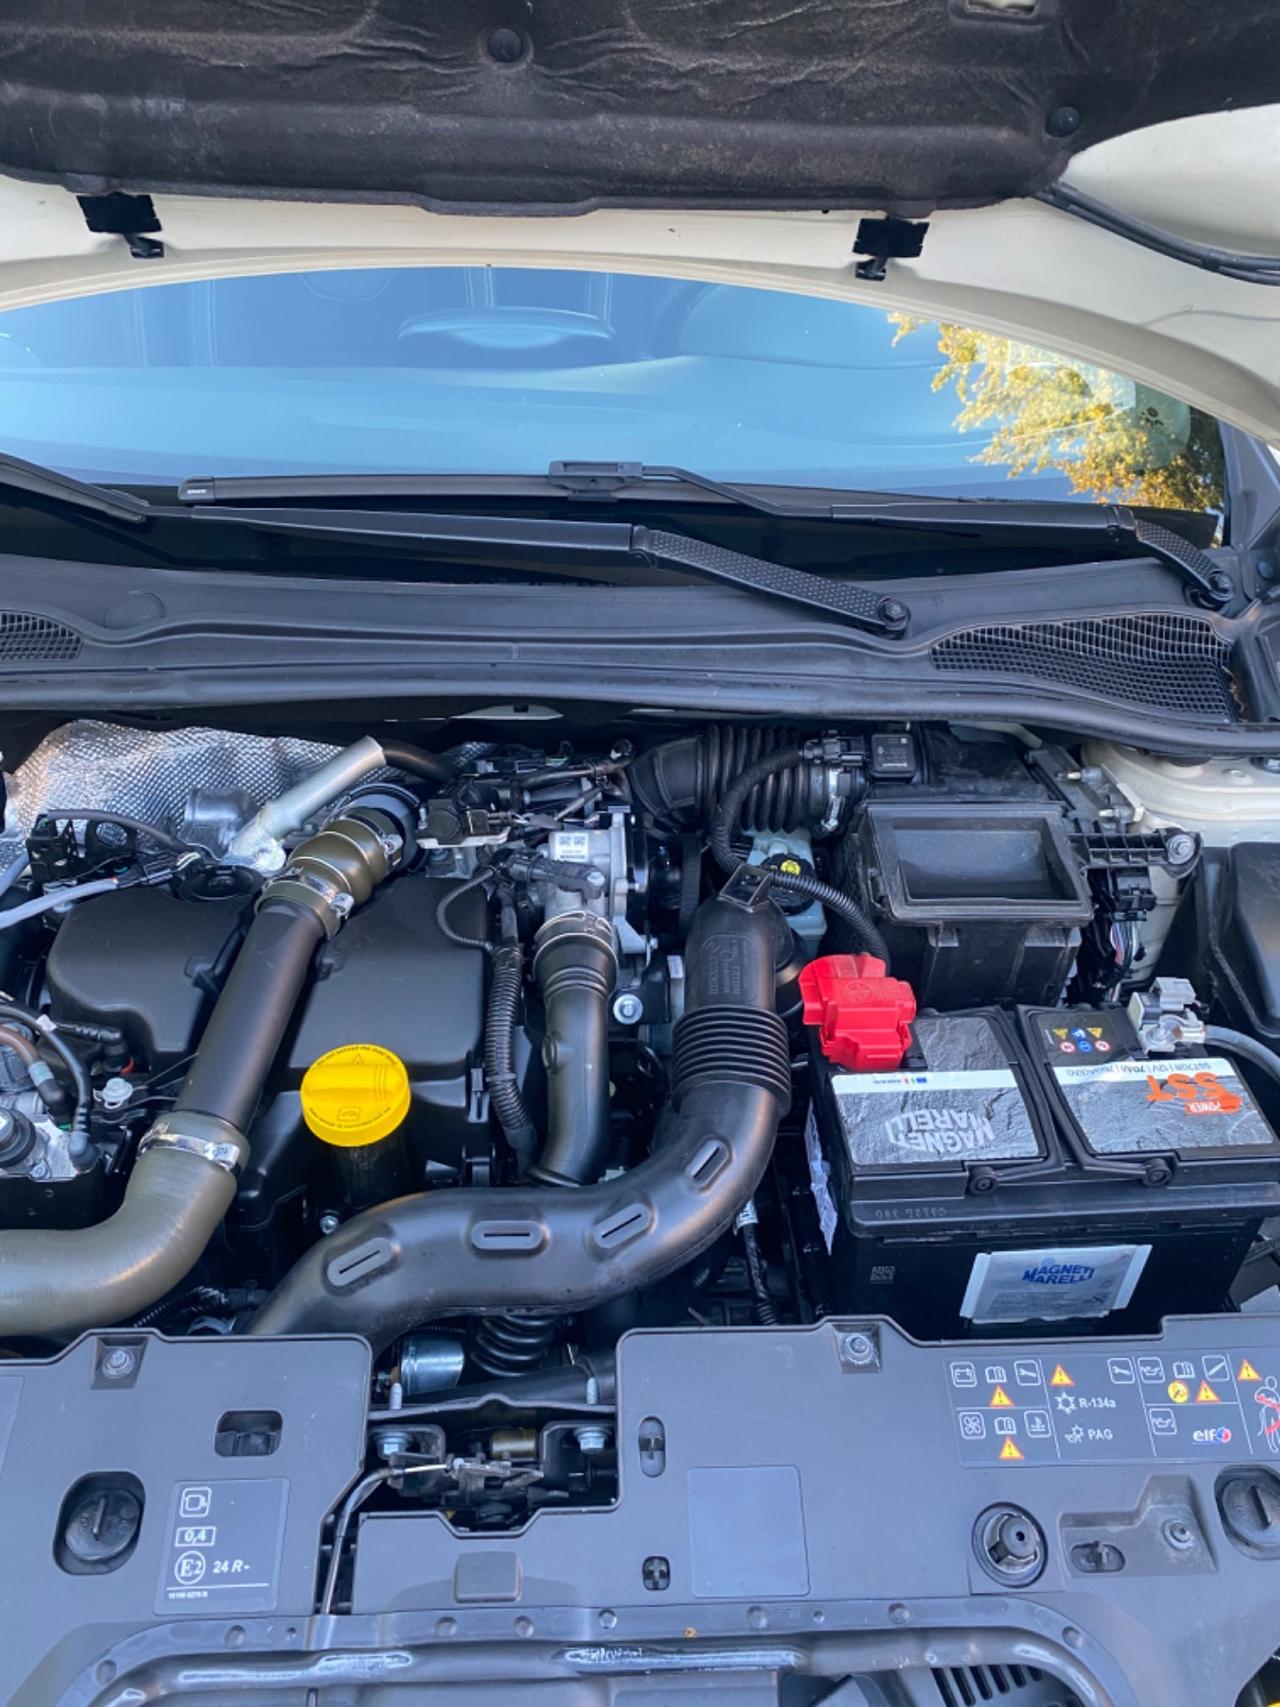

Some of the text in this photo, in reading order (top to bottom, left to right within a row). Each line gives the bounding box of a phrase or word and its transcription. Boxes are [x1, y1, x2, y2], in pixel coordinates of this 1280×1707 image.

[1145, 1071, 1226, 1102] SST
[1187, 1101, 1222, 1113] POWER
[885, 1109, 989, 1132] MARELLI
[885, 1121, 995, 1153] MAGNETI
[1023, 1263, 1095, 1279] MAGNETI
[1025, 1273, 1093, 1284] MARELLI
[1078, 1396, 1117, 1409] R-134a
[1088, 1428, 1113, 1441] PAG
[1192, 1427, 1217, 1442] elf
[184, 1529, 206, 1545] 0,4
[179, 1558, 203, 1578] E2
[212, 1560, 229, 1574] 24
